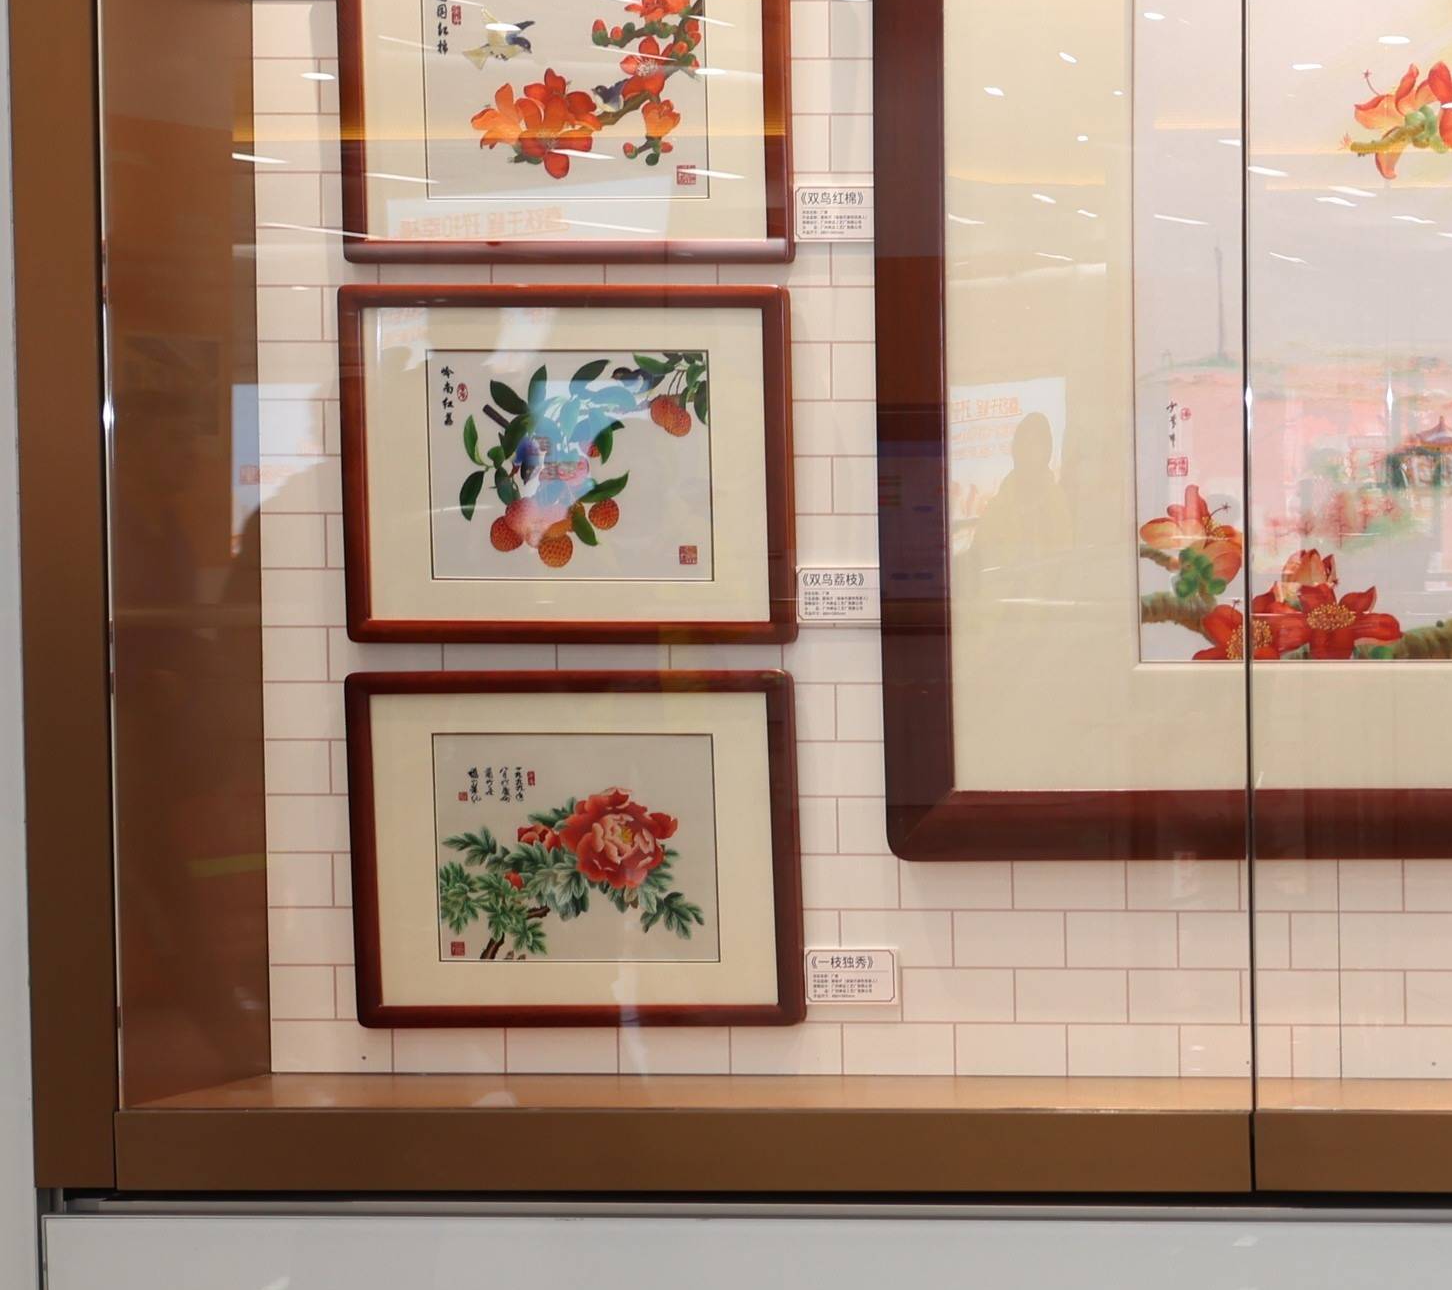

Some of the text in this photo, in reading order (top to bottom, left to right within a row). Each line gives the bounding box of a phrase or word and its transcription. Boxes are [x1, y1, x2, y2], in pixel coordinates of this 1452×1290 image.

[801, 191, 864, 205] 《双鸟红棉》
[802, 573, 865, 587] 《双鸟荔枝》
[811, 956, 874, 969] 《一枝独秀》
